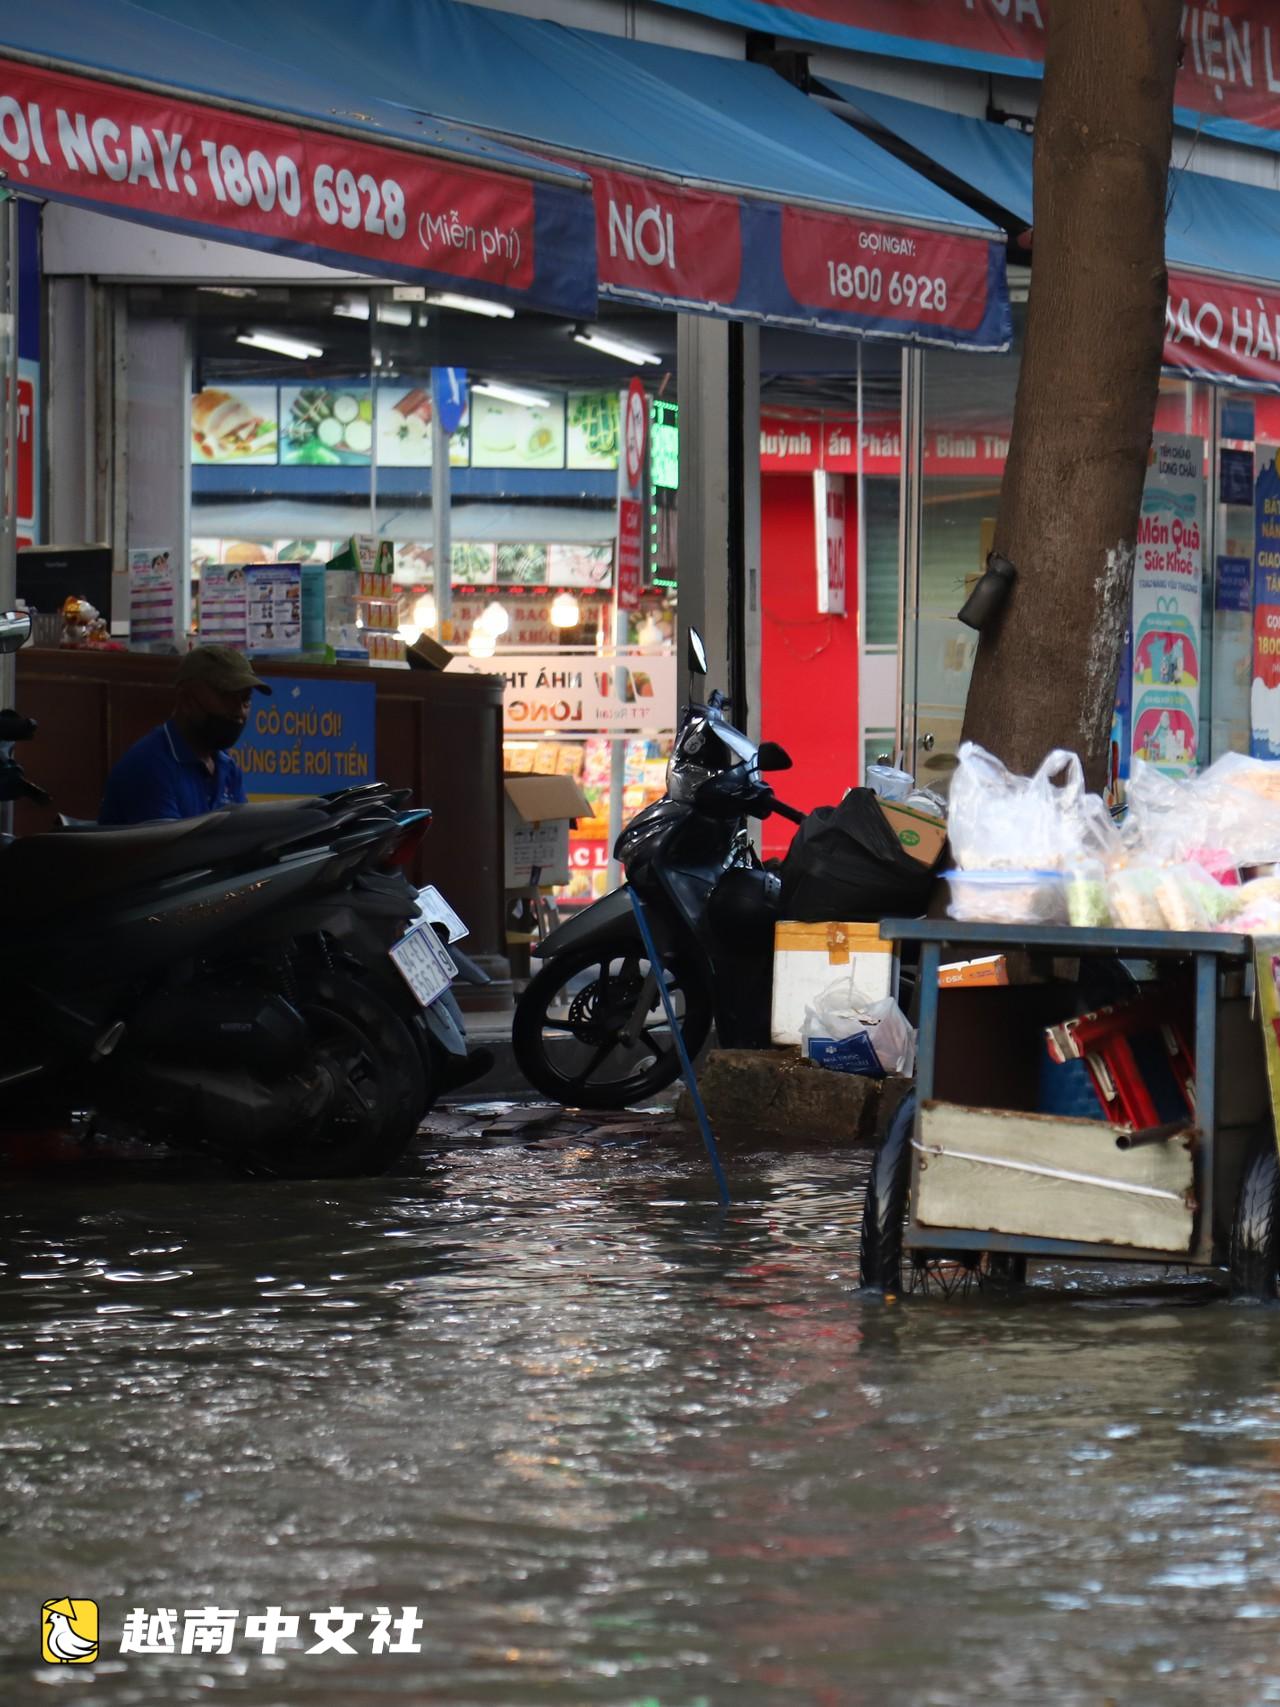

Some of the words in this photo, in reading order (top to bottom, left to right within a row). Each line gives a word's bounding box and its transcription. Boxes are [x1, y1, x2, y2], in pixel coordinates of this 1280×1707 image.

[56, 109, 198, 197] NGAY:
[201, 140, 301, 217] 1800
[313, 164, 406, 240] 6928
[418, 209, 477, 252] (Miễn
[481, 226, 521, 269] phí)
[608, 199, 676, 269] NƠI
[858, 231, 882, 255] GỌI
[882, 236, 916, 256] NGAY:
[827, 260, 882, 302] 1800
[888, 271, 947, 312] 6928
[1258, 551, 1280, 569] GIAO
[1267, 615, 1280, 631] GỌI
[283, 705, 317, 737] CHÚ
[304, 749, 331, 775] RƠI
